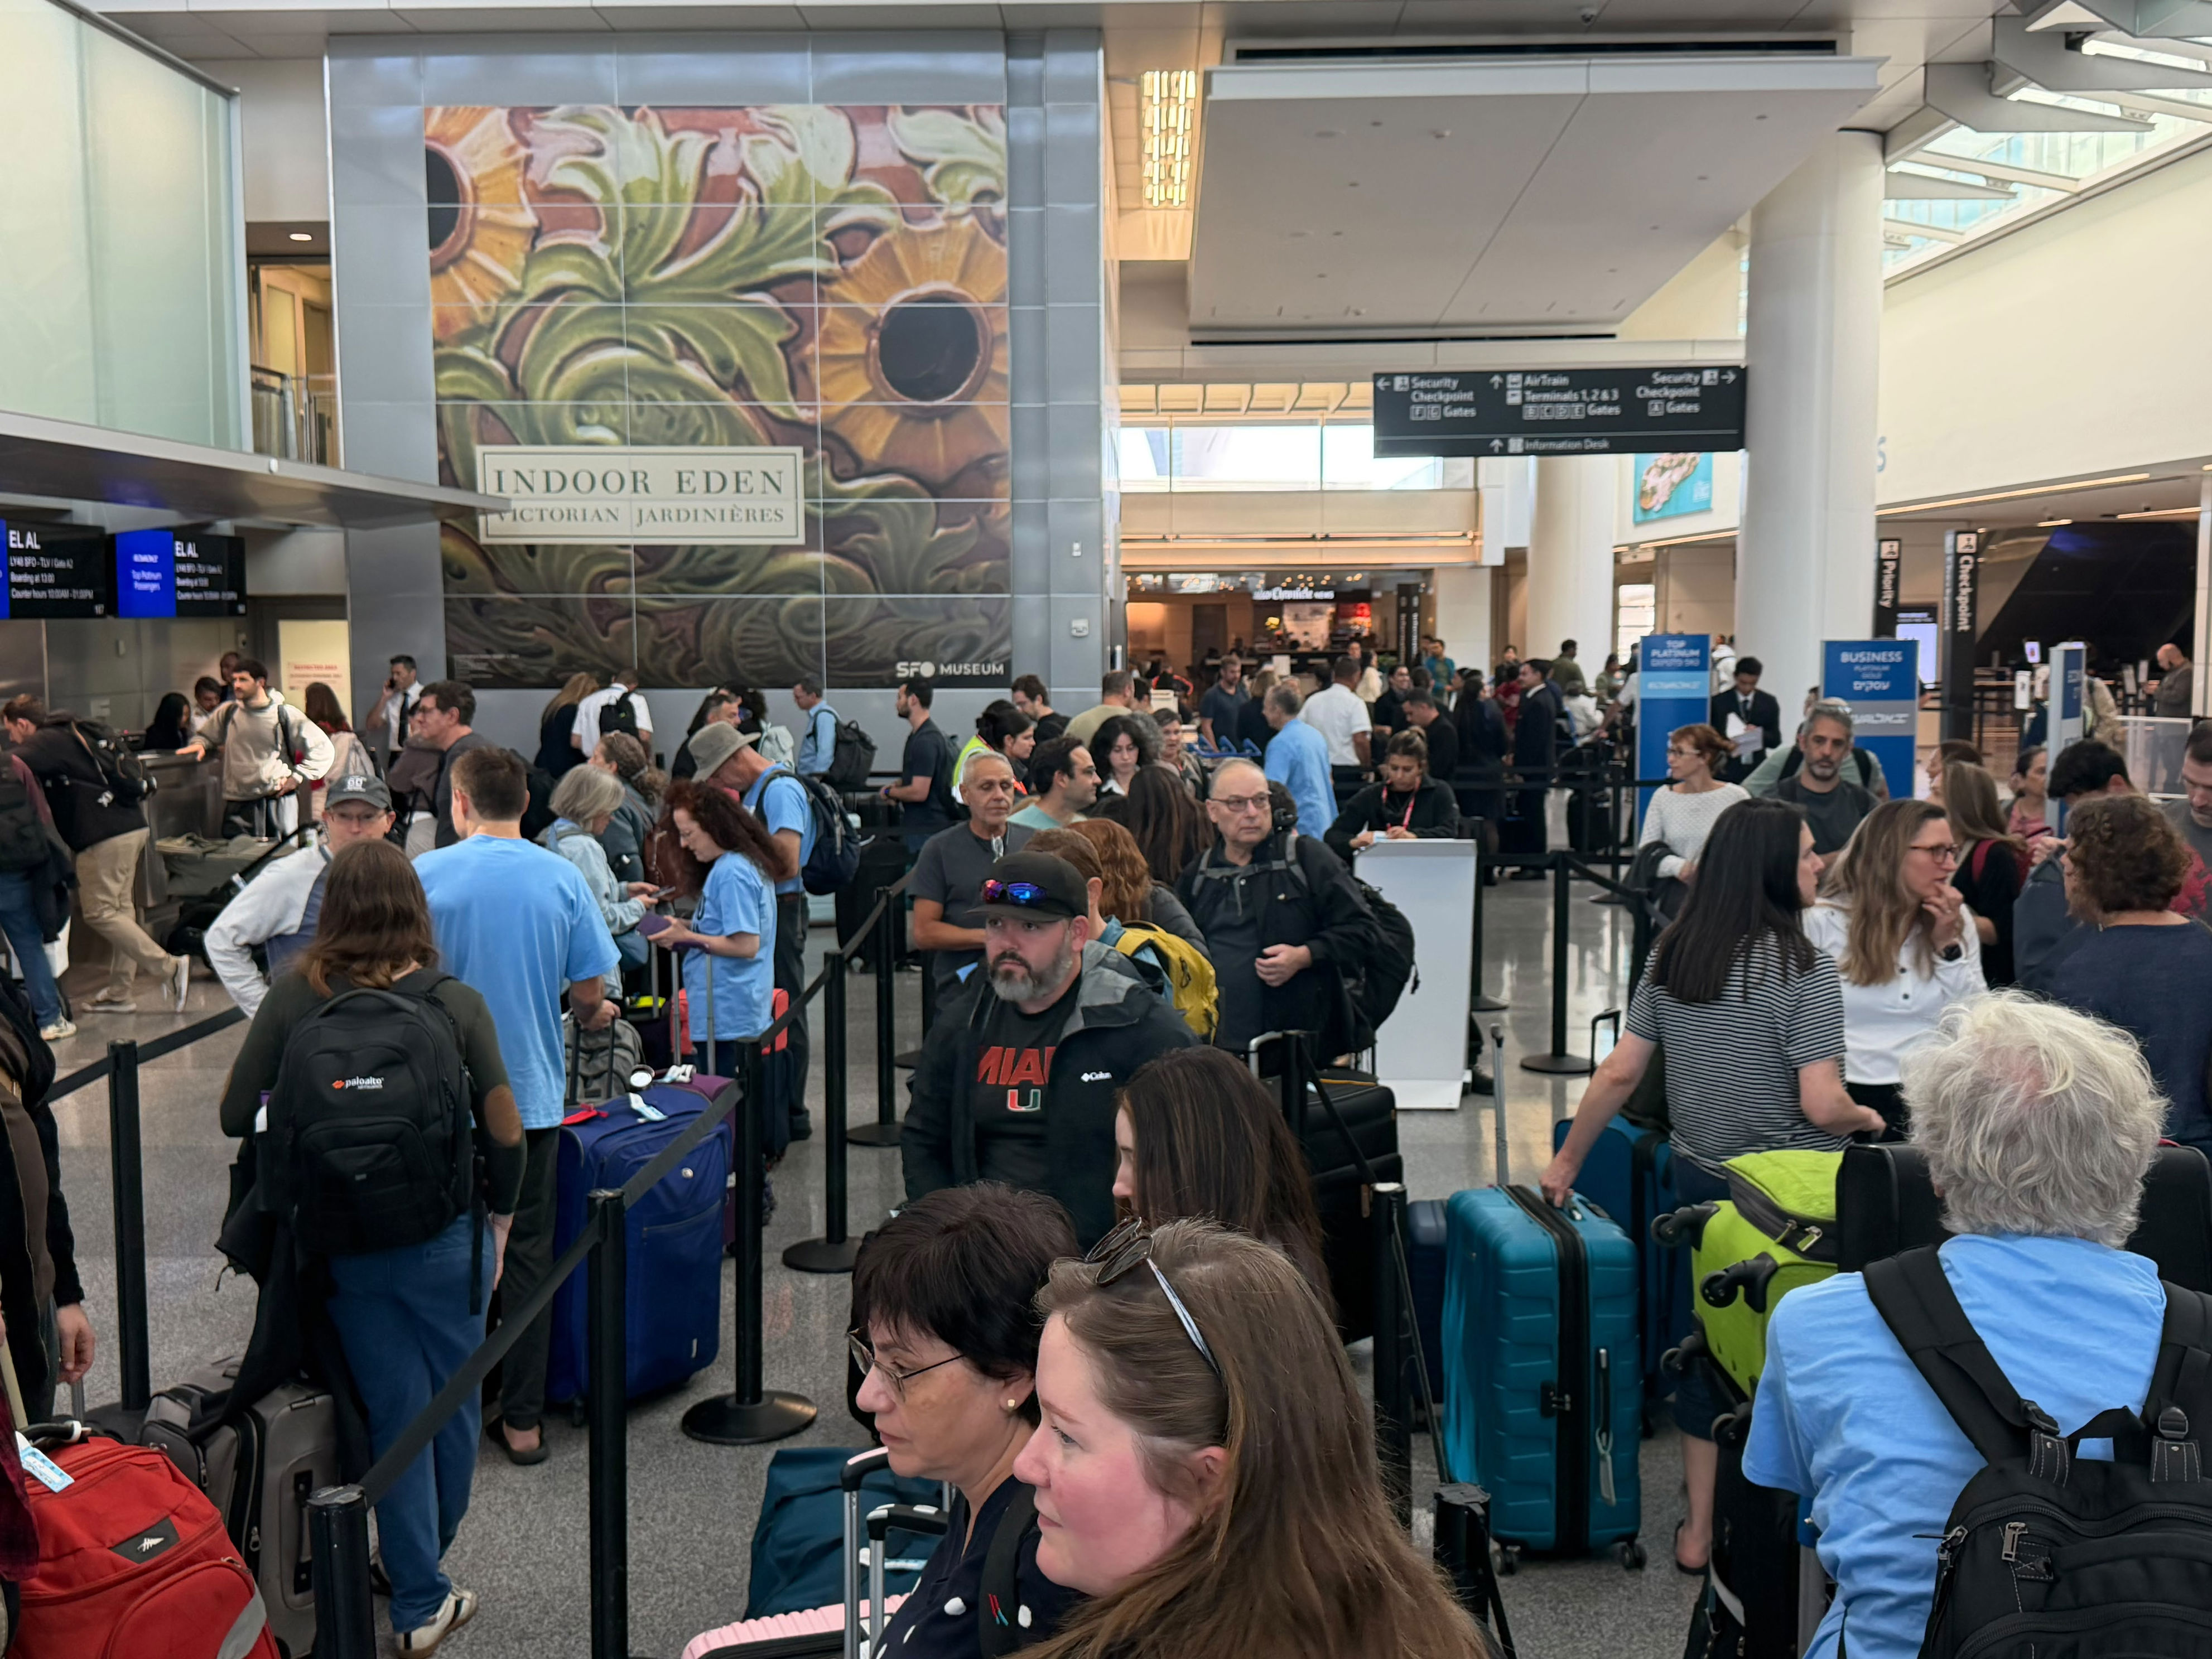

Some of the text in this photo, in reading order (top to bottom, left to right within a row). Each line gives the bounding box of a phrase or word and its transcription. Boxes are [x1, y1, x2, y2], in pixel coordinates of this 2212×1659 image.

[1410, 377, 1459, 390] Security
[1524, 374, 1569, 387] AirTrain
[1652, 371, 1701, 385] Security
[1410, 390, 1474, 403] Checkpoint
[1524, 390, 1579, 402] Terminals
[1591, 388, 1600, 401] 2
[1601, 389, 1609, 401] &
[1611, 388, 1620, 401] 3
[1636, 385, 1701, 399] Checkpoint
[1443, 405, 1477, 418] Gates
[1587, 403, 1621, 416] Gates
[1666, 401, 1700, 413] Gates
[1525, 437, 1611, 450] Information Desk
[495, 469, 783, 495] INDOOR EDEN
[498, 504, 783, 526] VICTORIAN JARDINIÈRES
[9, 529, 41, 549] EL AL
[175, 541, 199, 558] EL AL
[1878, 560, 1896, 608] Priority
[1955, 555, 1974, 632] Checkpoint
[1650, 649, 1700, 658] PLATINUM
[1840, 651, 1903, 663] BUSINESS
[896, 661, 1004, 678] SFO MUSEUM
[978, 1046, 1056, 1086] MIA
[345, 1076, 382, 1089] paloalto
[1007, 1088, 1041, 1112] U
